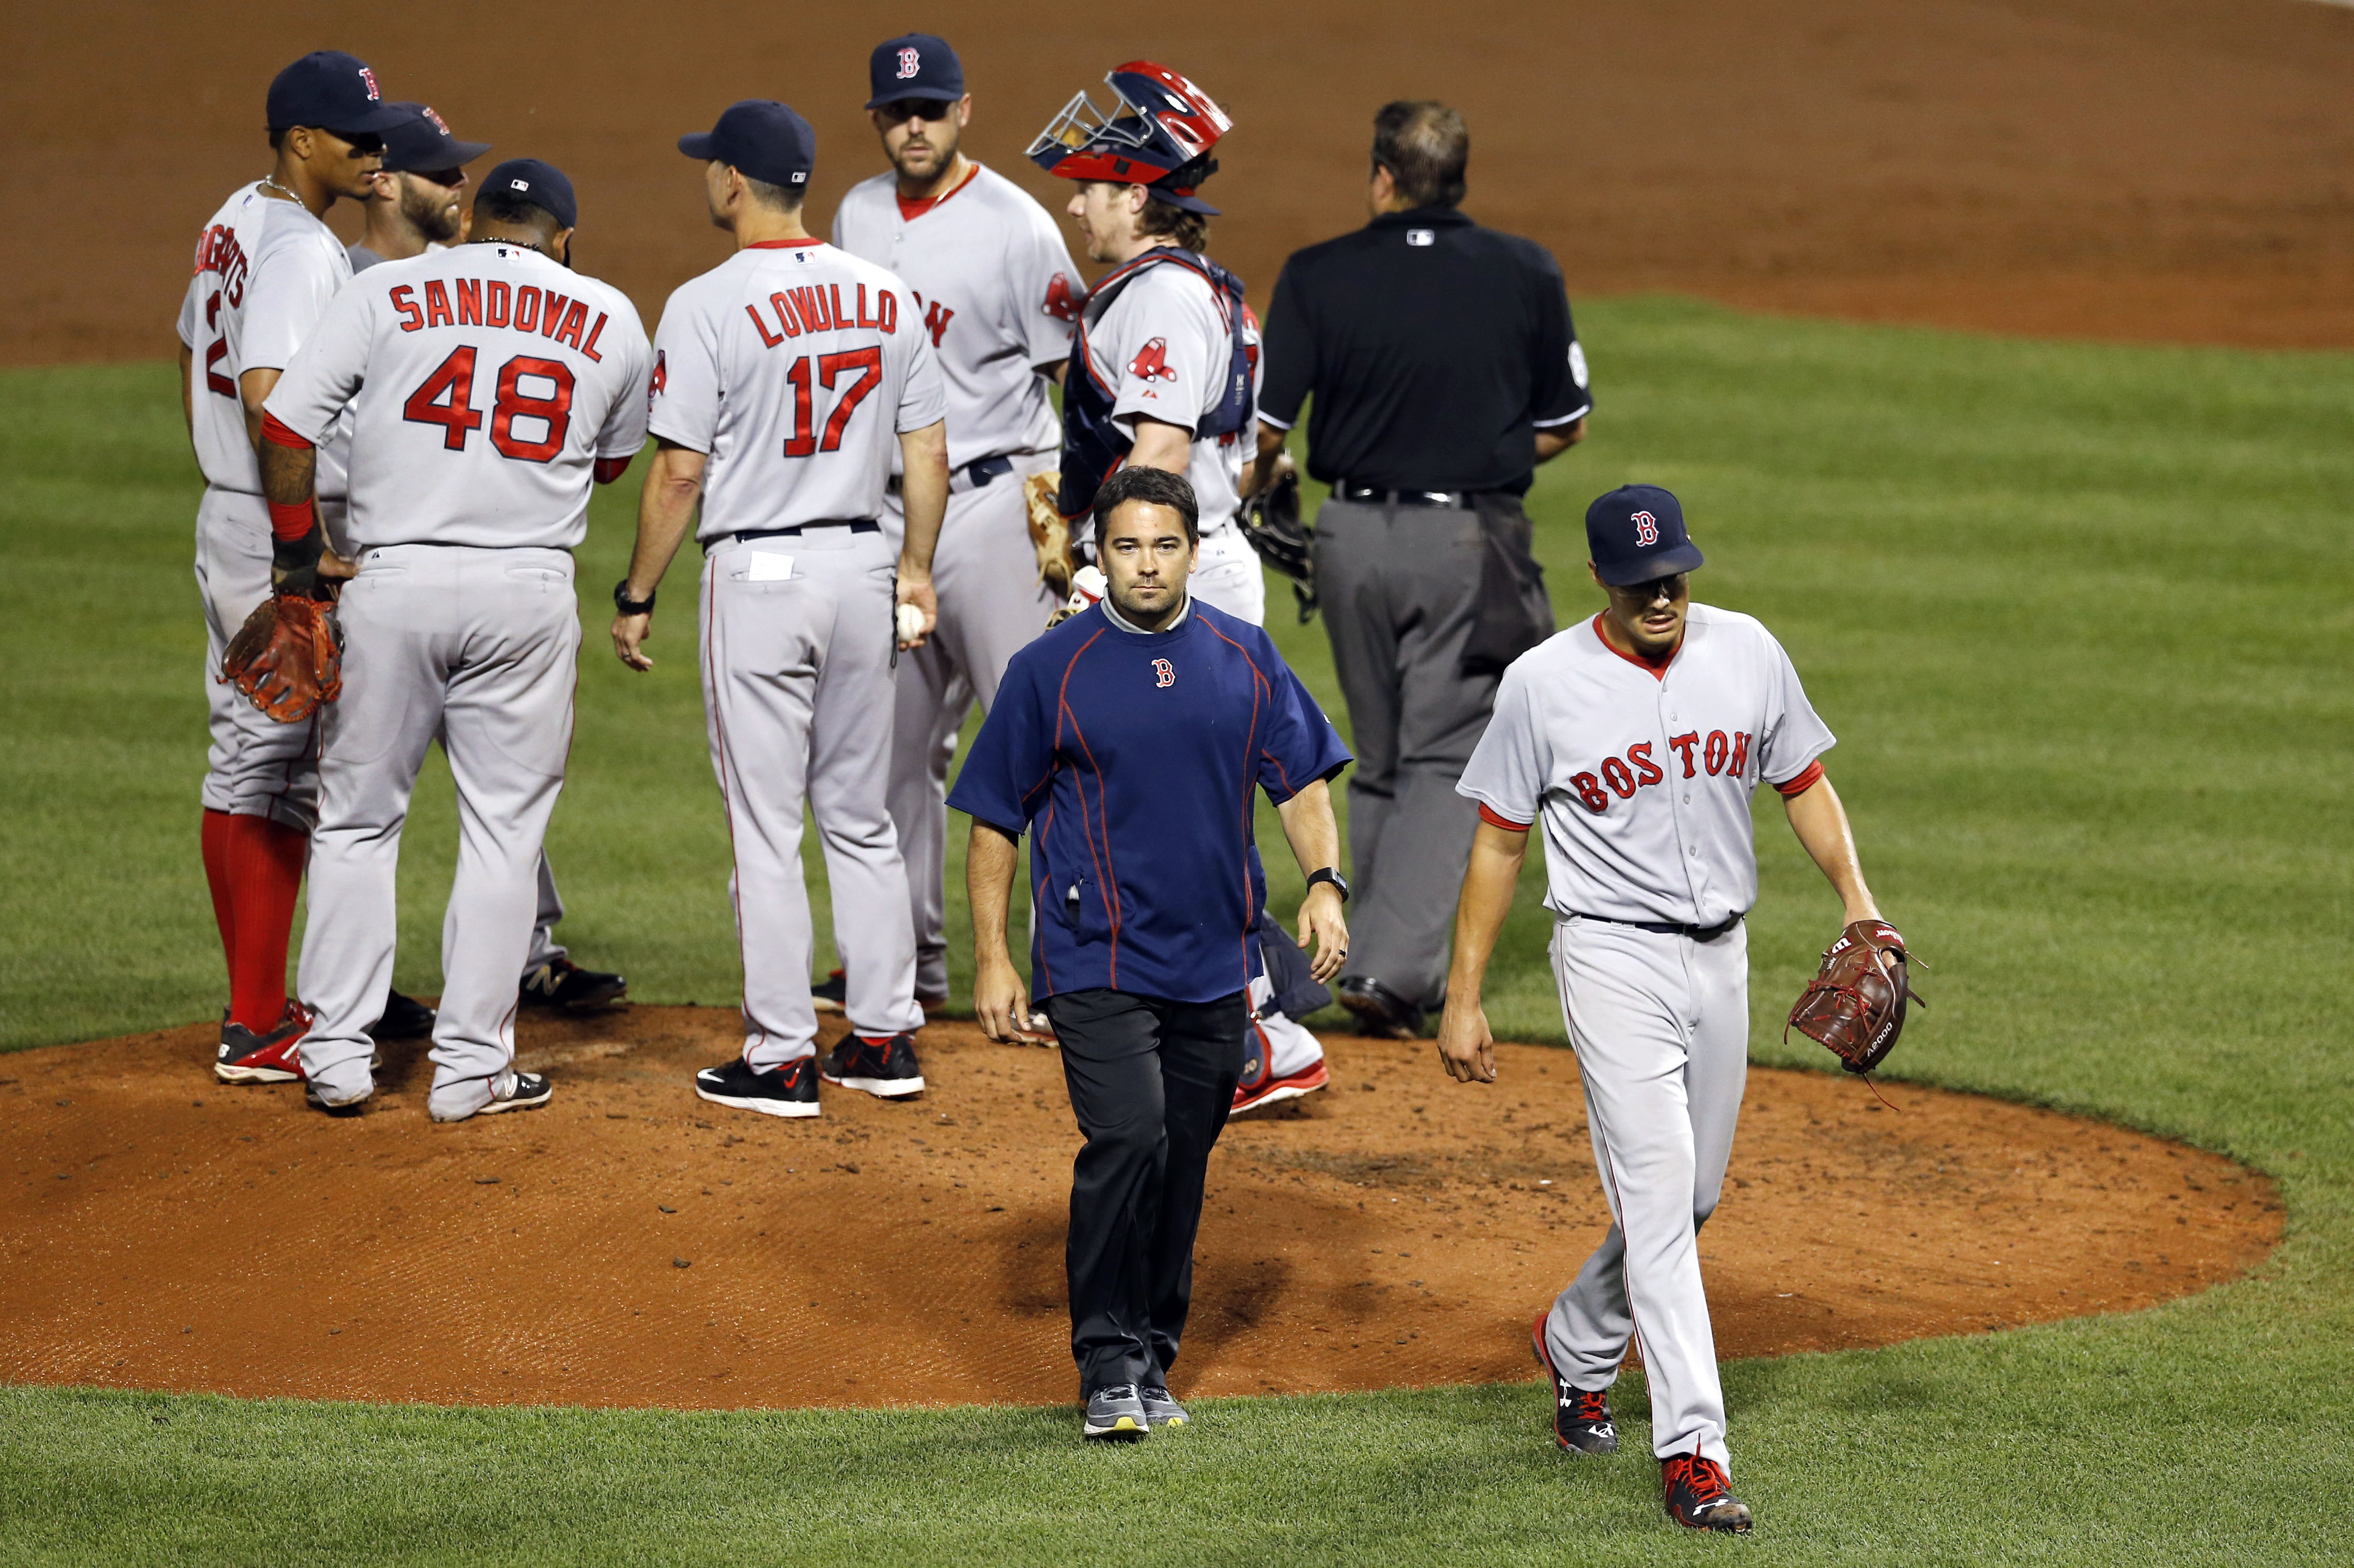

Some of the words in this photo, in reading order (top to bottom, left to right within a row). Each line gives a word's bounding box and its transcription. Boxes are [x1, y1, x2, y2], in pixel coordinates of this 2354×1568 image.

[896, 47, 921, 79] B
[389, 278, 608, 364] SANDOVAL
[746, 284, 897, 349] LOVULLO
[404, 345, 575, 463] 48
[784, 345, 882, 458] 17
[1631, 511, 1659, 547] B
[1151, 658, 1176, 688] B
[1570, 729, 1751, 812] BOSTON
[1867, 1022, 1893, 1057] A2000
